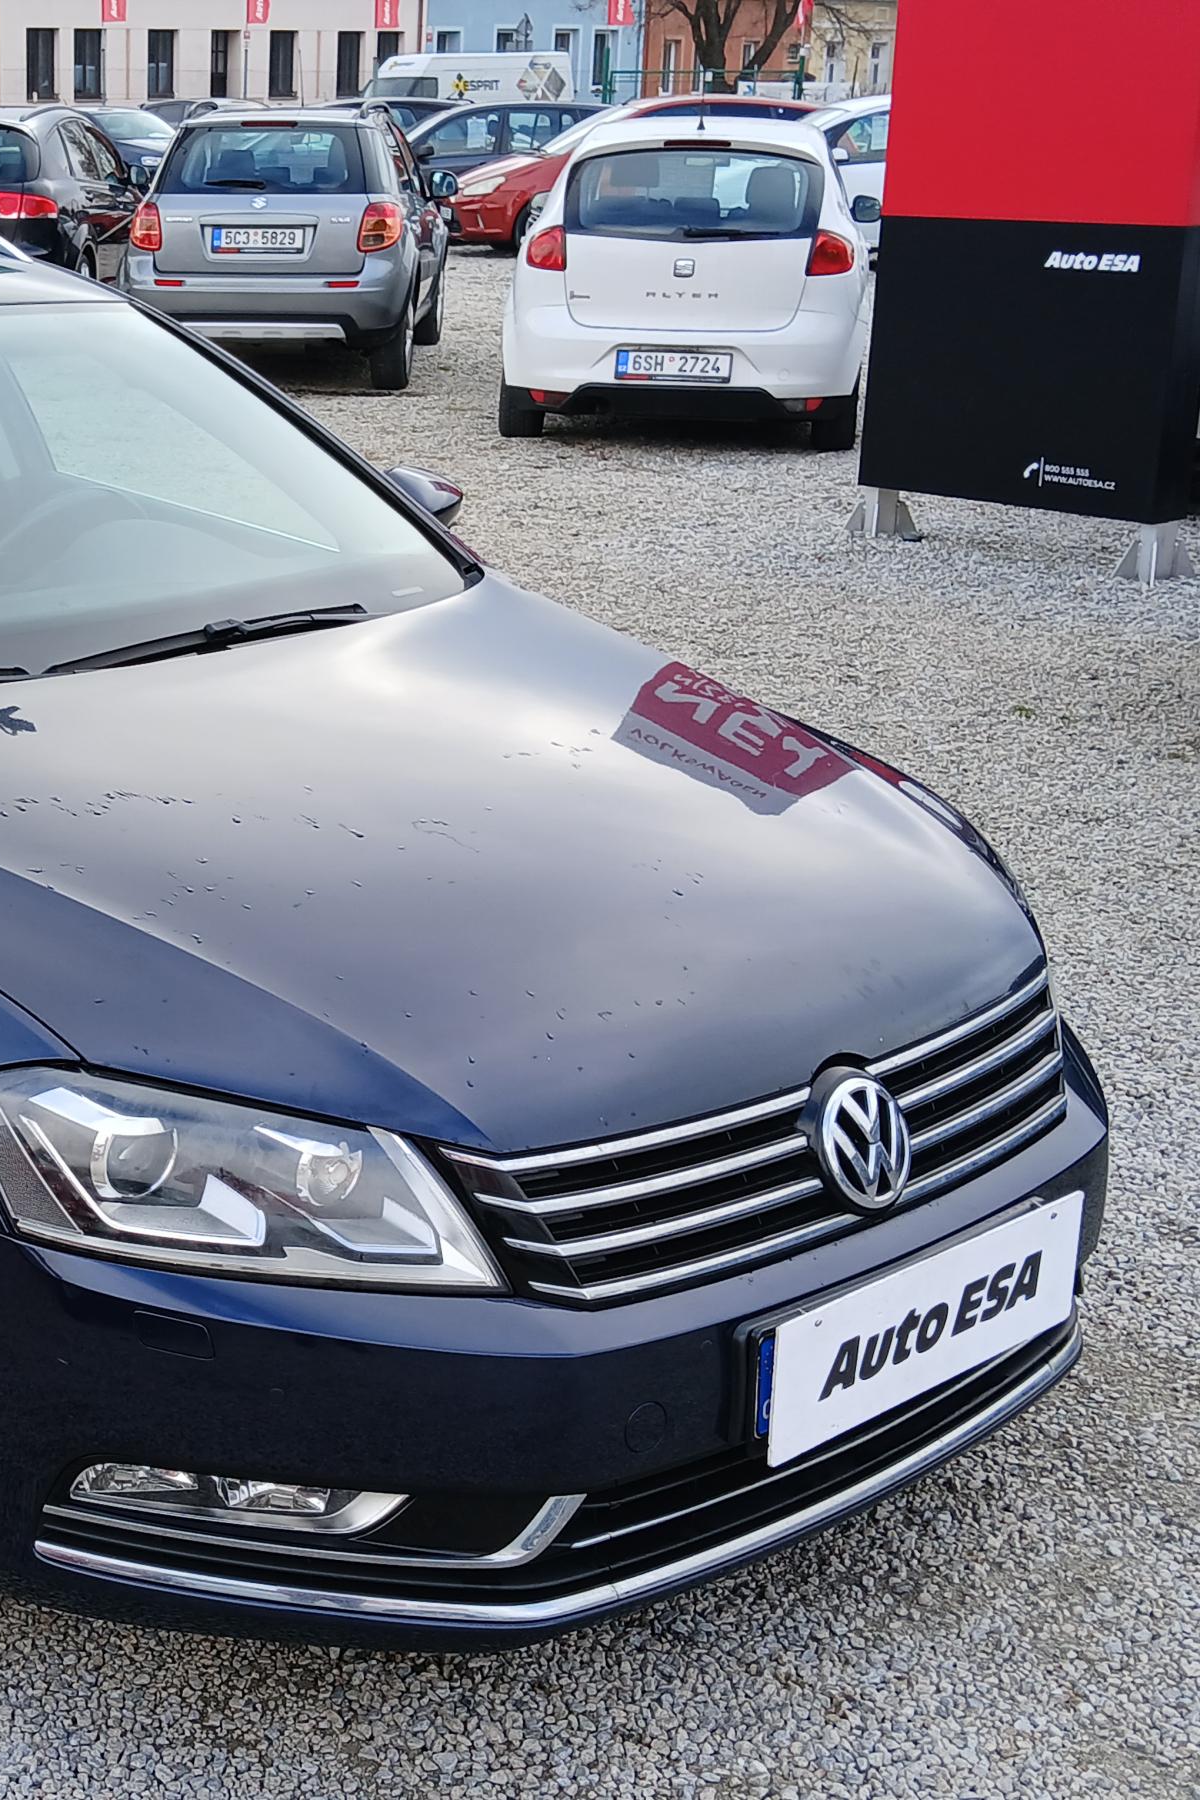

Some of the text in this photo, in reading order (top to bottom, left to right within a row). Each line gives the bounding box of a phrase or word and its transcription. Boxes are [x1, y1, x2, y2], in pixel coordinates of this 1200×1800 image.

[463, 79, 500, 91] ESPRIT
[224, 231, 250, 245] 5C3
[261, 231, 296, 245] 5829
[1044, 251, 1140, 272] Auto ESA
[632, 355, 720, 373] 6SH 2724
[1044, 464, 1090, 477] 800 555 555
[1044, 474, 1116, 490] WWW.AUTOESA.CZ
[818, 1250, 1043, 1402] Auto ESA
